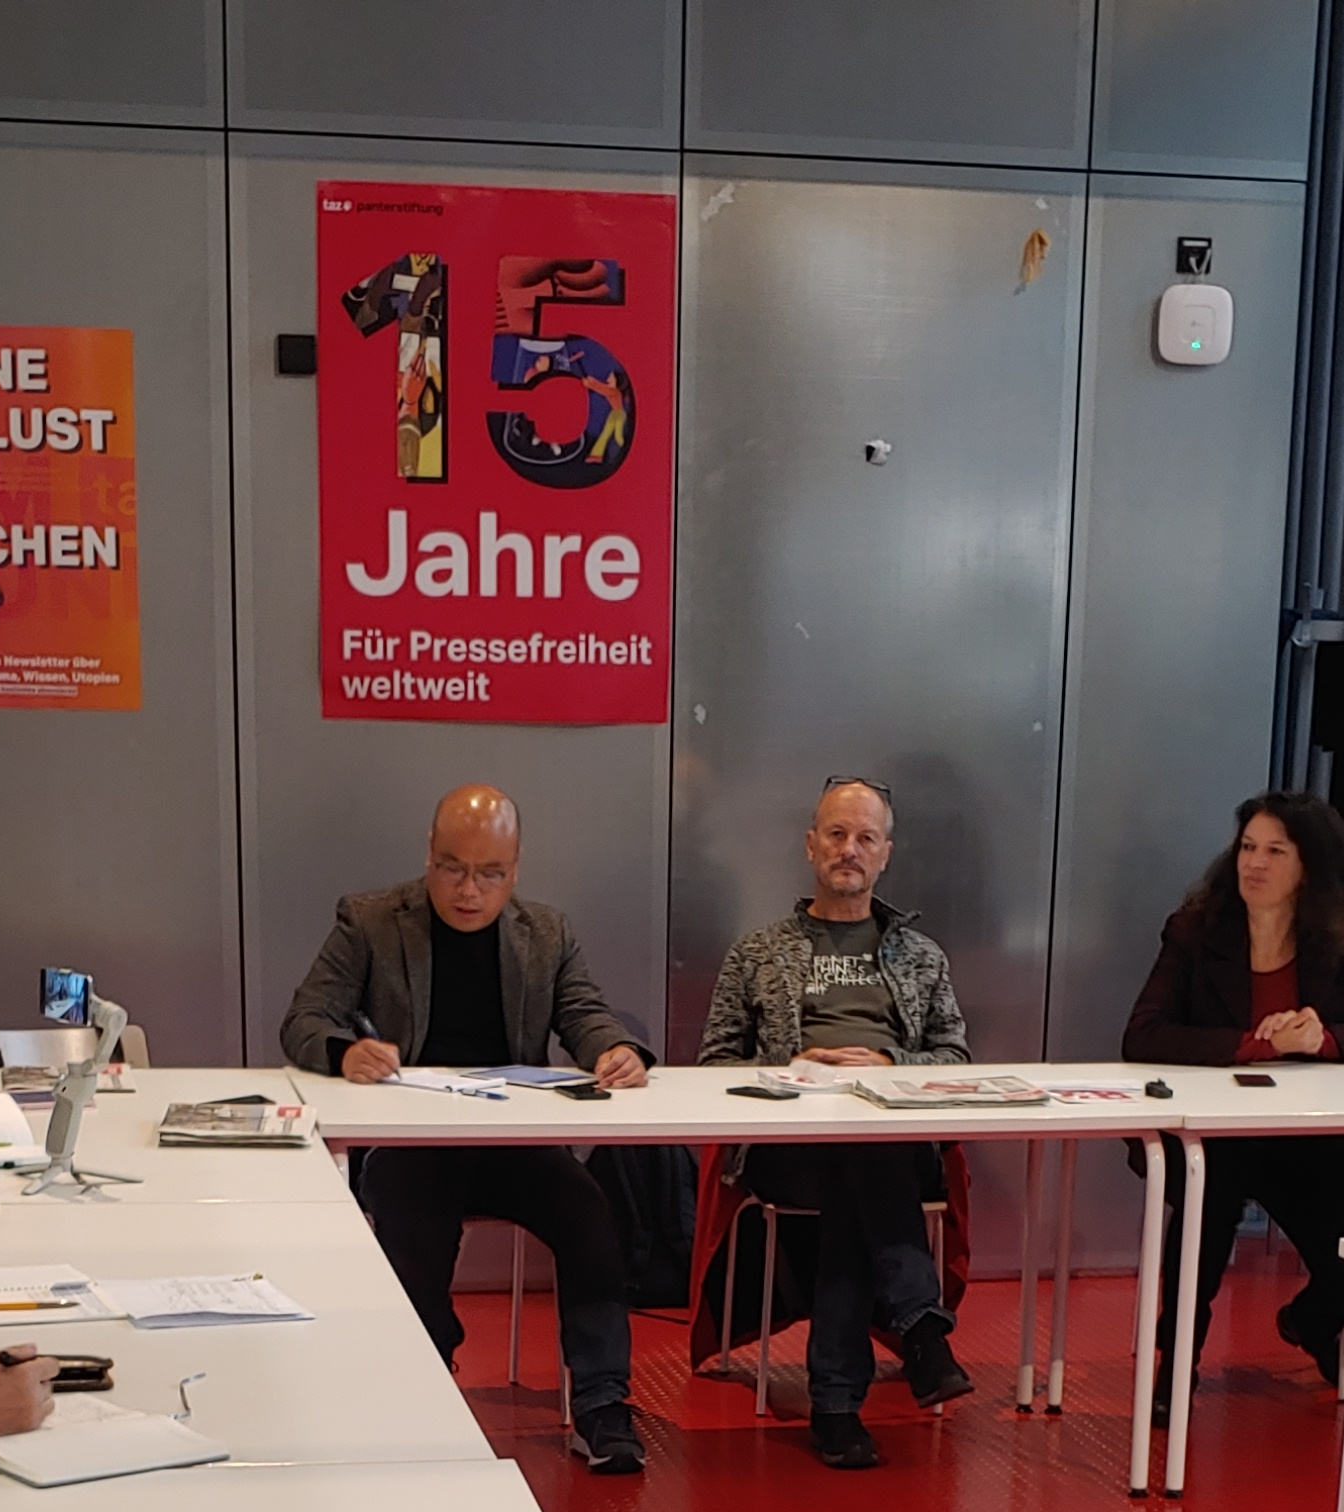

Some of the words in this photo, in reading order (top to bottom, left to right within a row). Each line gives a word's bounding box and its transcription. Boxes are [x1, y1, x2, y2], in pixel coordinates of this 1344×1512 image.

[323, 198, 343, 211] taz
[357, 202, 444, 216] panterstiftung
[340, 252, 637, 489] 15
[345, 508, 641, 601] Jahre
[342, 629, 400, 661] Für
[408, 629, 653, 665] Pressefreiheit
[4, 655, 69, 668] Newsletter
[72, 656, 101, 669] über
[22, 671, 70, 684] Wissen,
[71, 671, 120, 685] Utopien
[341, 670, 491, 702] weltweit
[813, 955, 858, 968] ERNET
